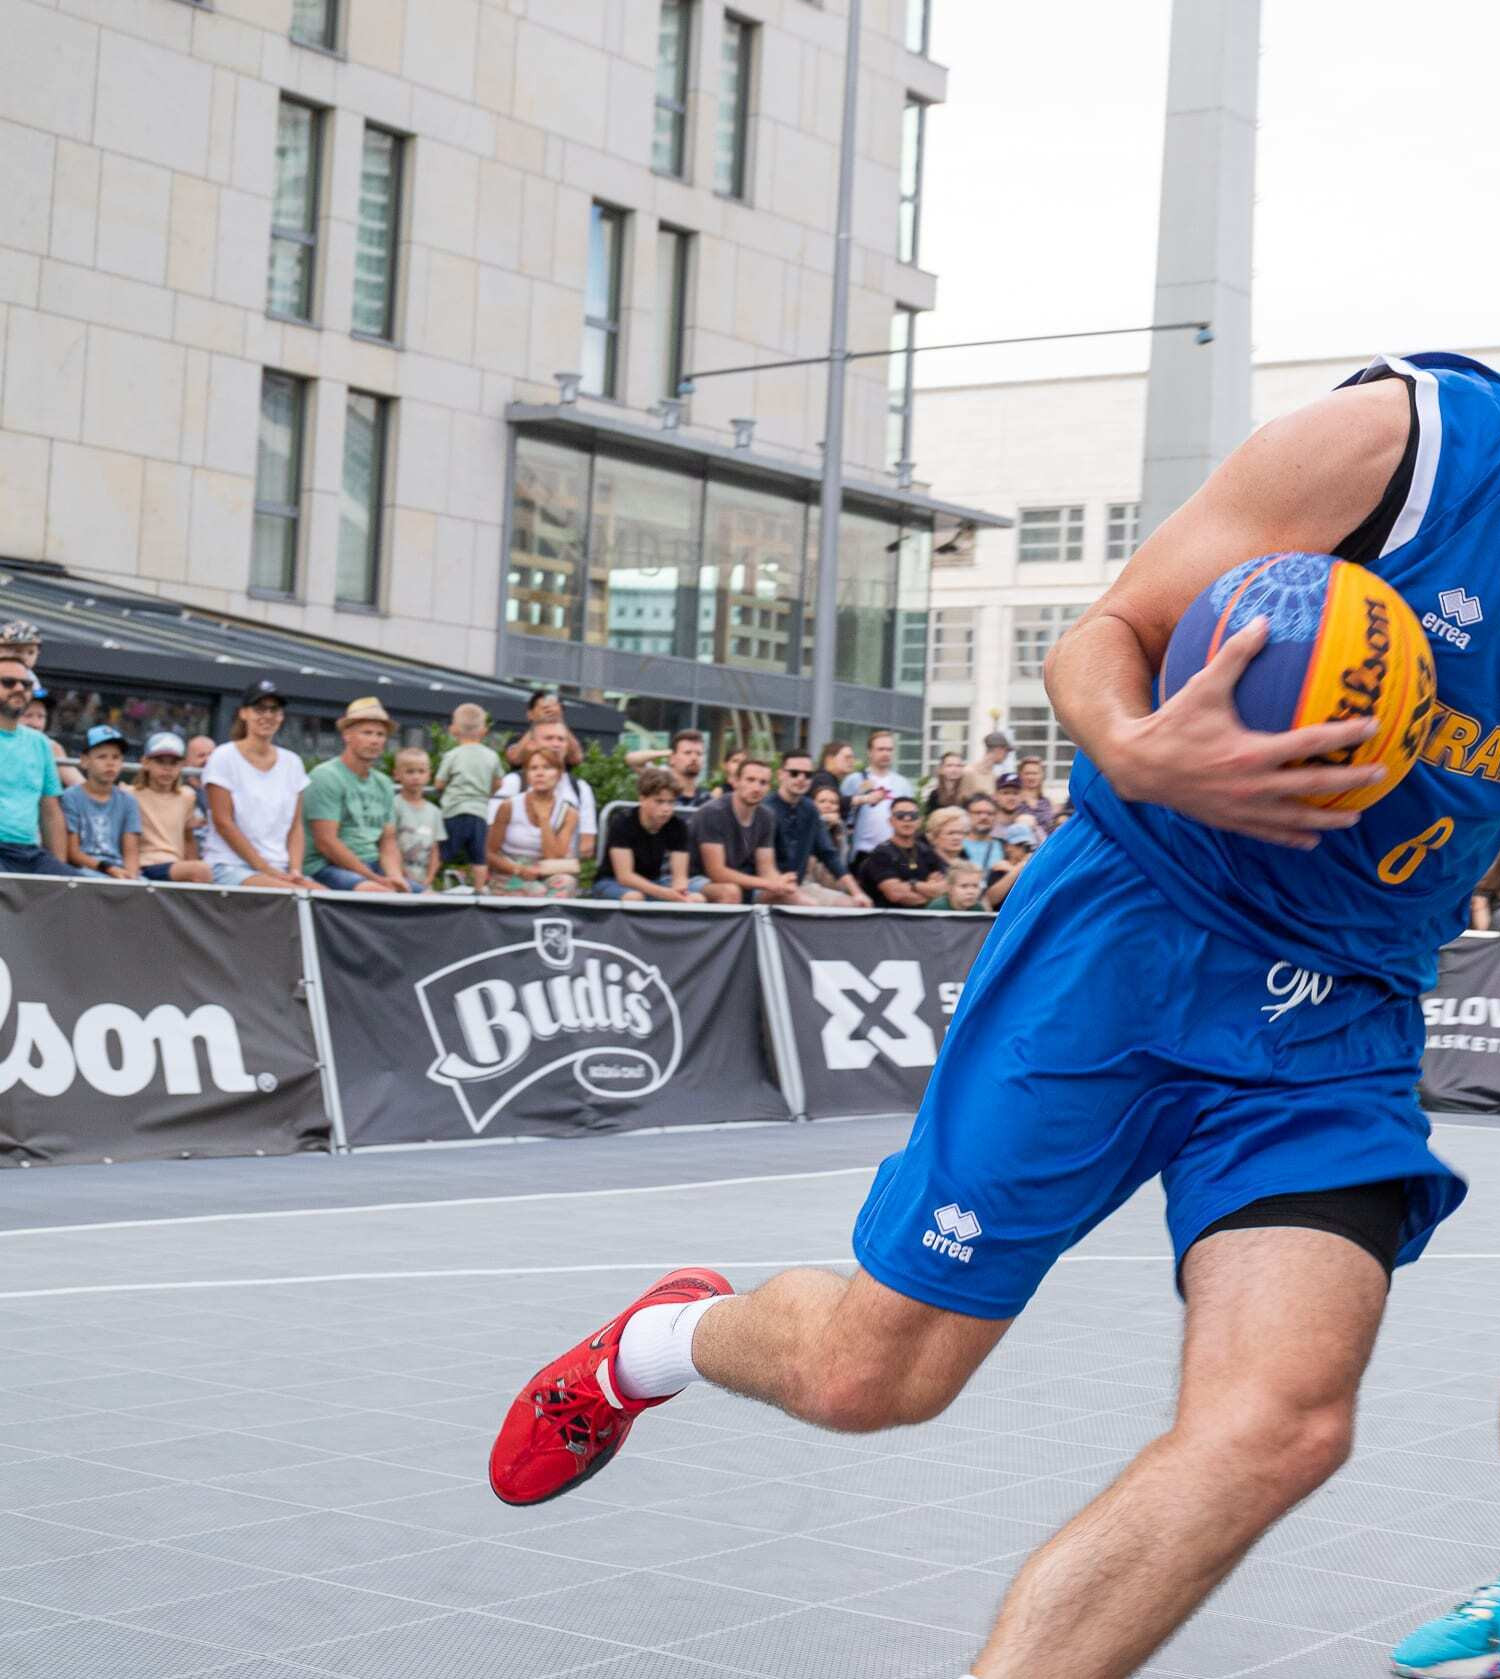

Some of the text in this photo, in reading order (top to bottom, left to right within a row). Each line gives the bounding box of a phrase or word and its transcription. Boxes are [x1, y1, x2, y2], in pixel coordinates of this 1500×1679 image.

[1421, 612, 1472, 650] errea
[1377, 815, 1455, 885] 8
[922, 1229, 974, 1264] errea
